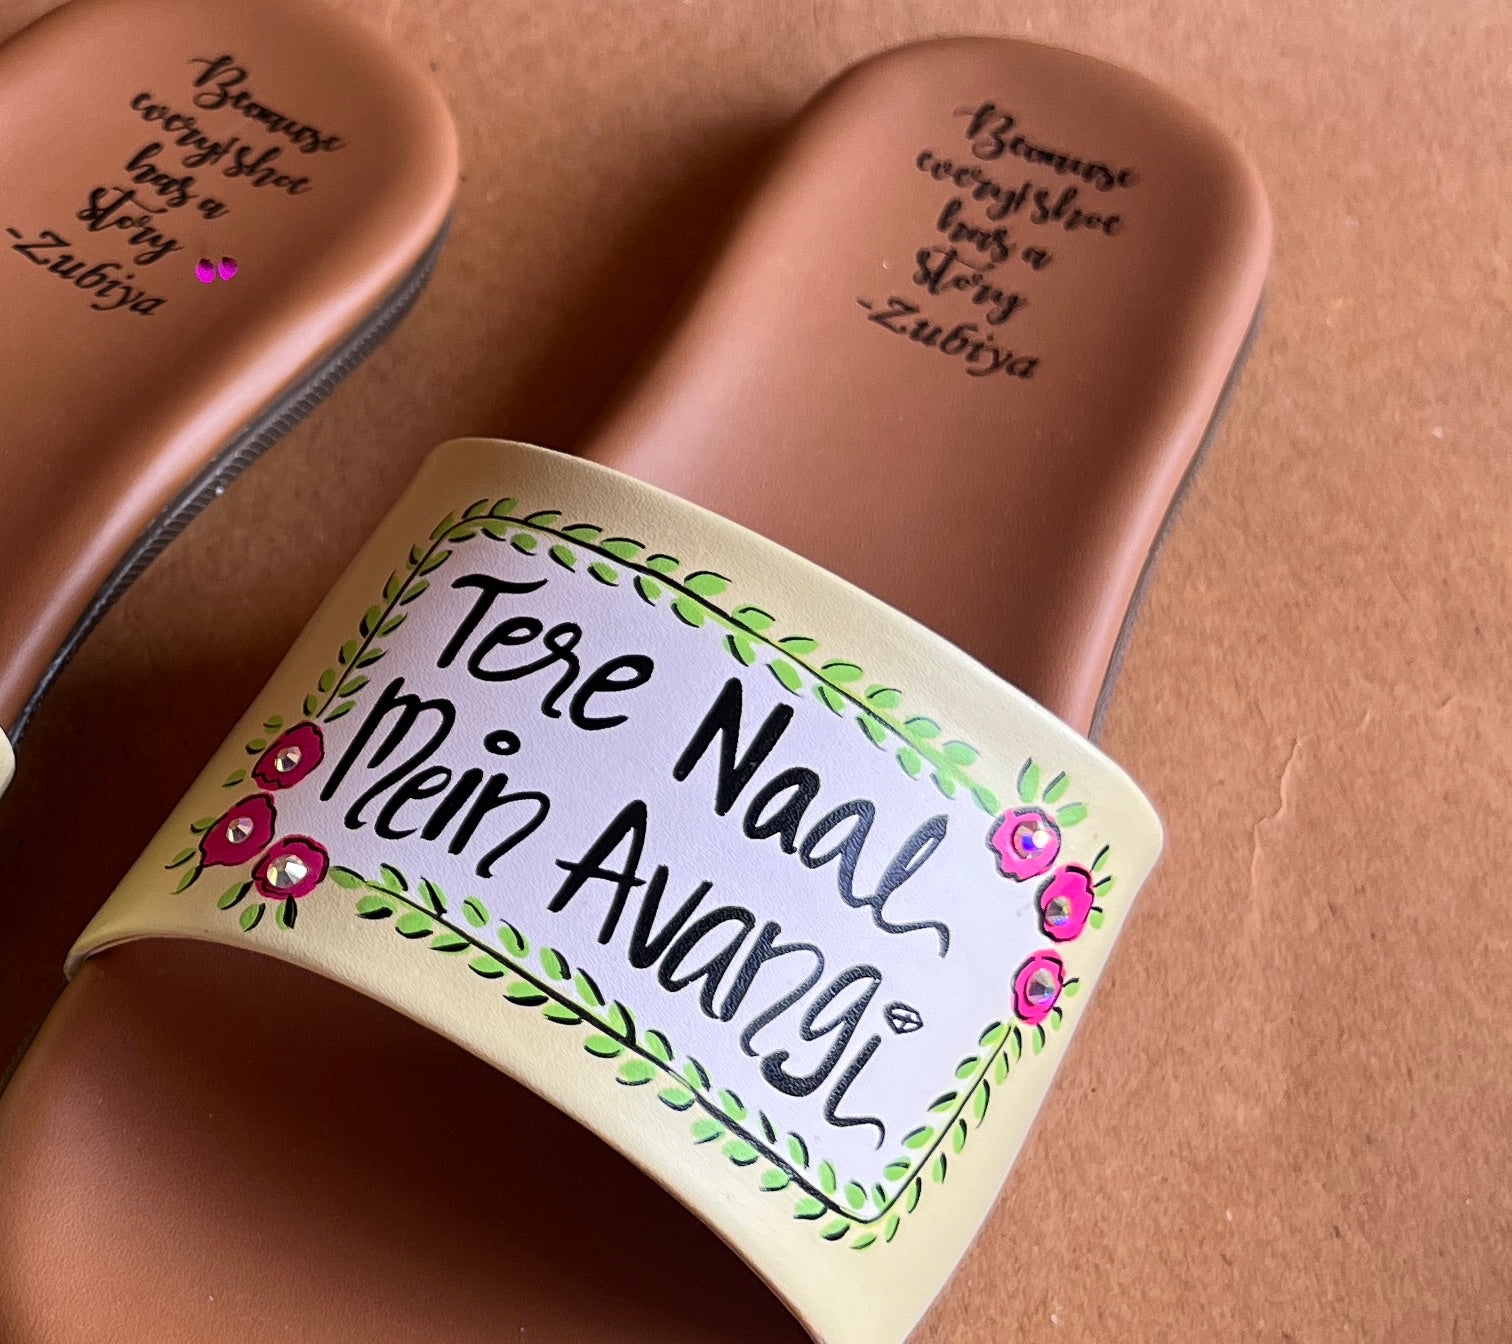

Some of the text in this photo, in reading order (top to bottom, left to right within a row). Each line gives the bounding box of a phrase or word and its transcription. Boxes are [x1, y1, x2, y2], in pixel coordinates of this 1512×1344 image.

[191, 55, 346, 154] Because
[953, 102, 1139, 193] Because
[125, 142, 230, 220] has a
[937, 197, 1053, 271] has a
[451, 572, 950, 958] Tere Naal
[547, 799, 924, 1150] Avangi
